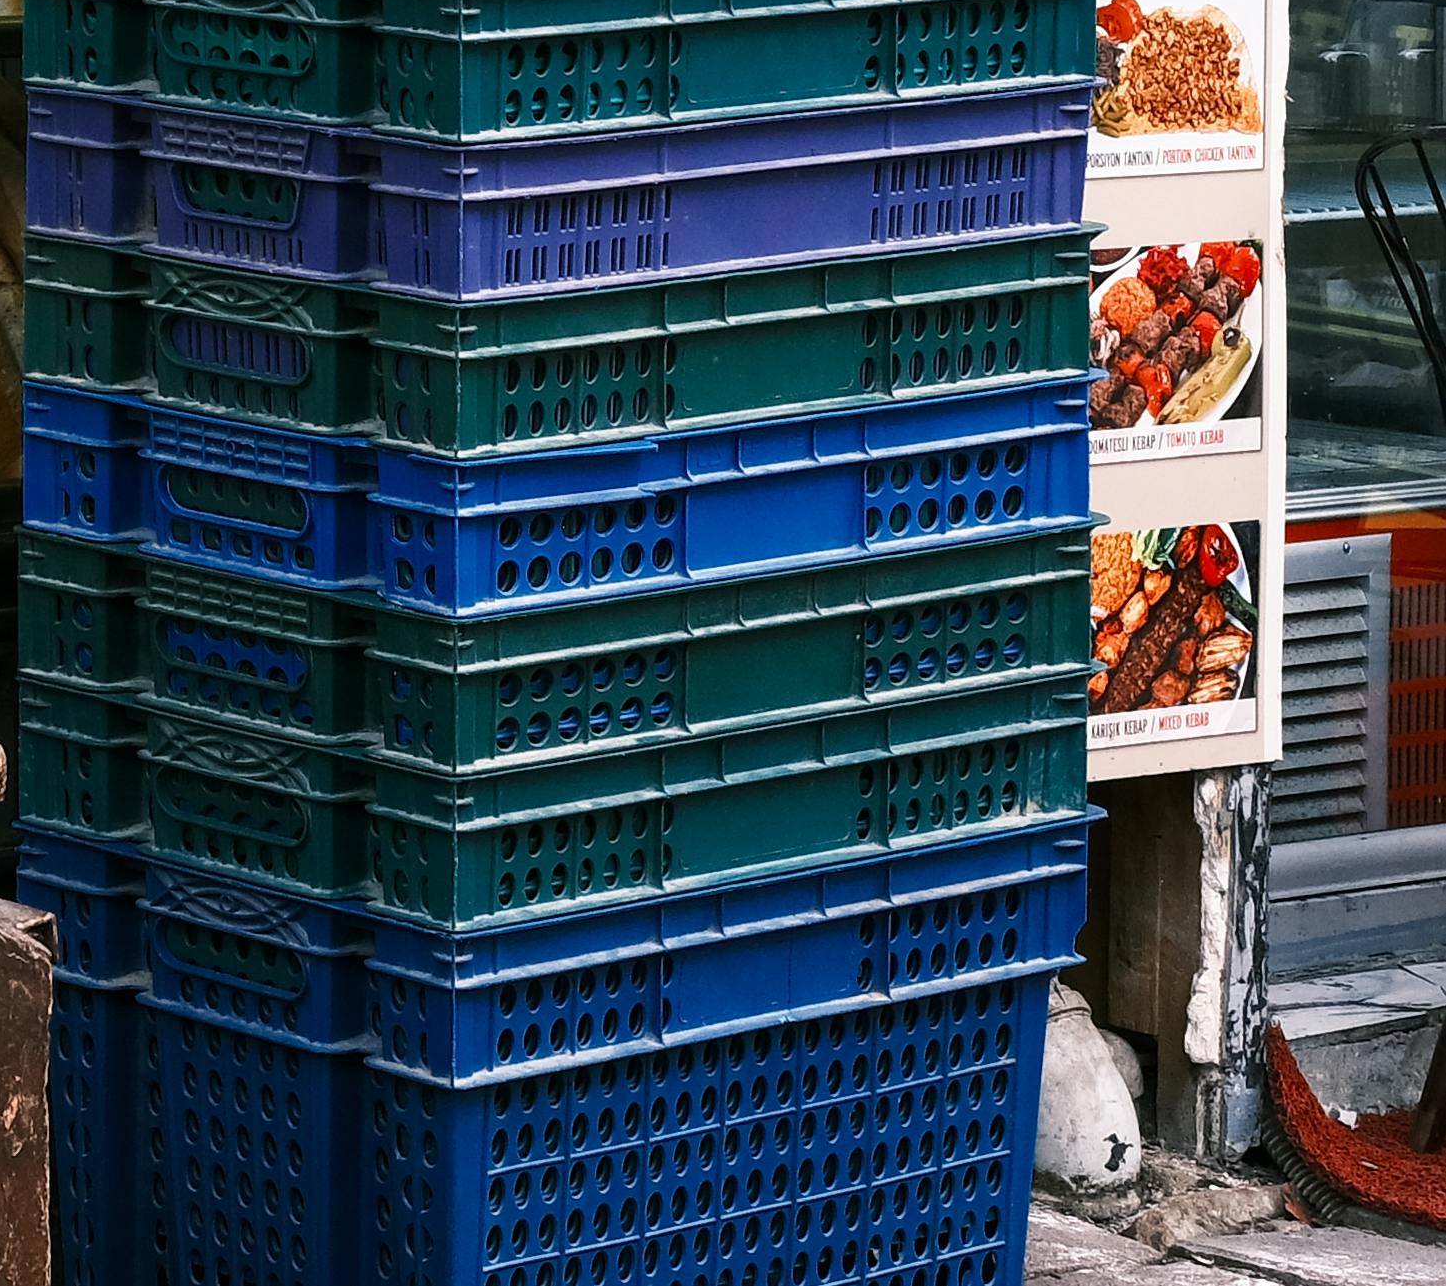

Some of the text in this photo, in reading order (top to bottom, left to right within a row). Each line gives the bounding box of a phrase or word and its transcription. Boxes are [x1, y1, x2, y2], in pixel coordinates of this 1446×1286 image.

[1163, 149, 1192, 164] PORTION
[1194, 146, 1224, 162] CHICKEN
[1132, 434, 1156, 450] KEBAP
[1166, 431, 1196, 447] TOMATO
[1199, 429, 1224, 445] KEBAB
[1091, 723, 1120, 741] KARIŞIK
[1124, 718, 1148, 735] KEBAP
[1158, 714, 1182, 731] MIXED
[1185, 711, 1210, 728] KEBAB
